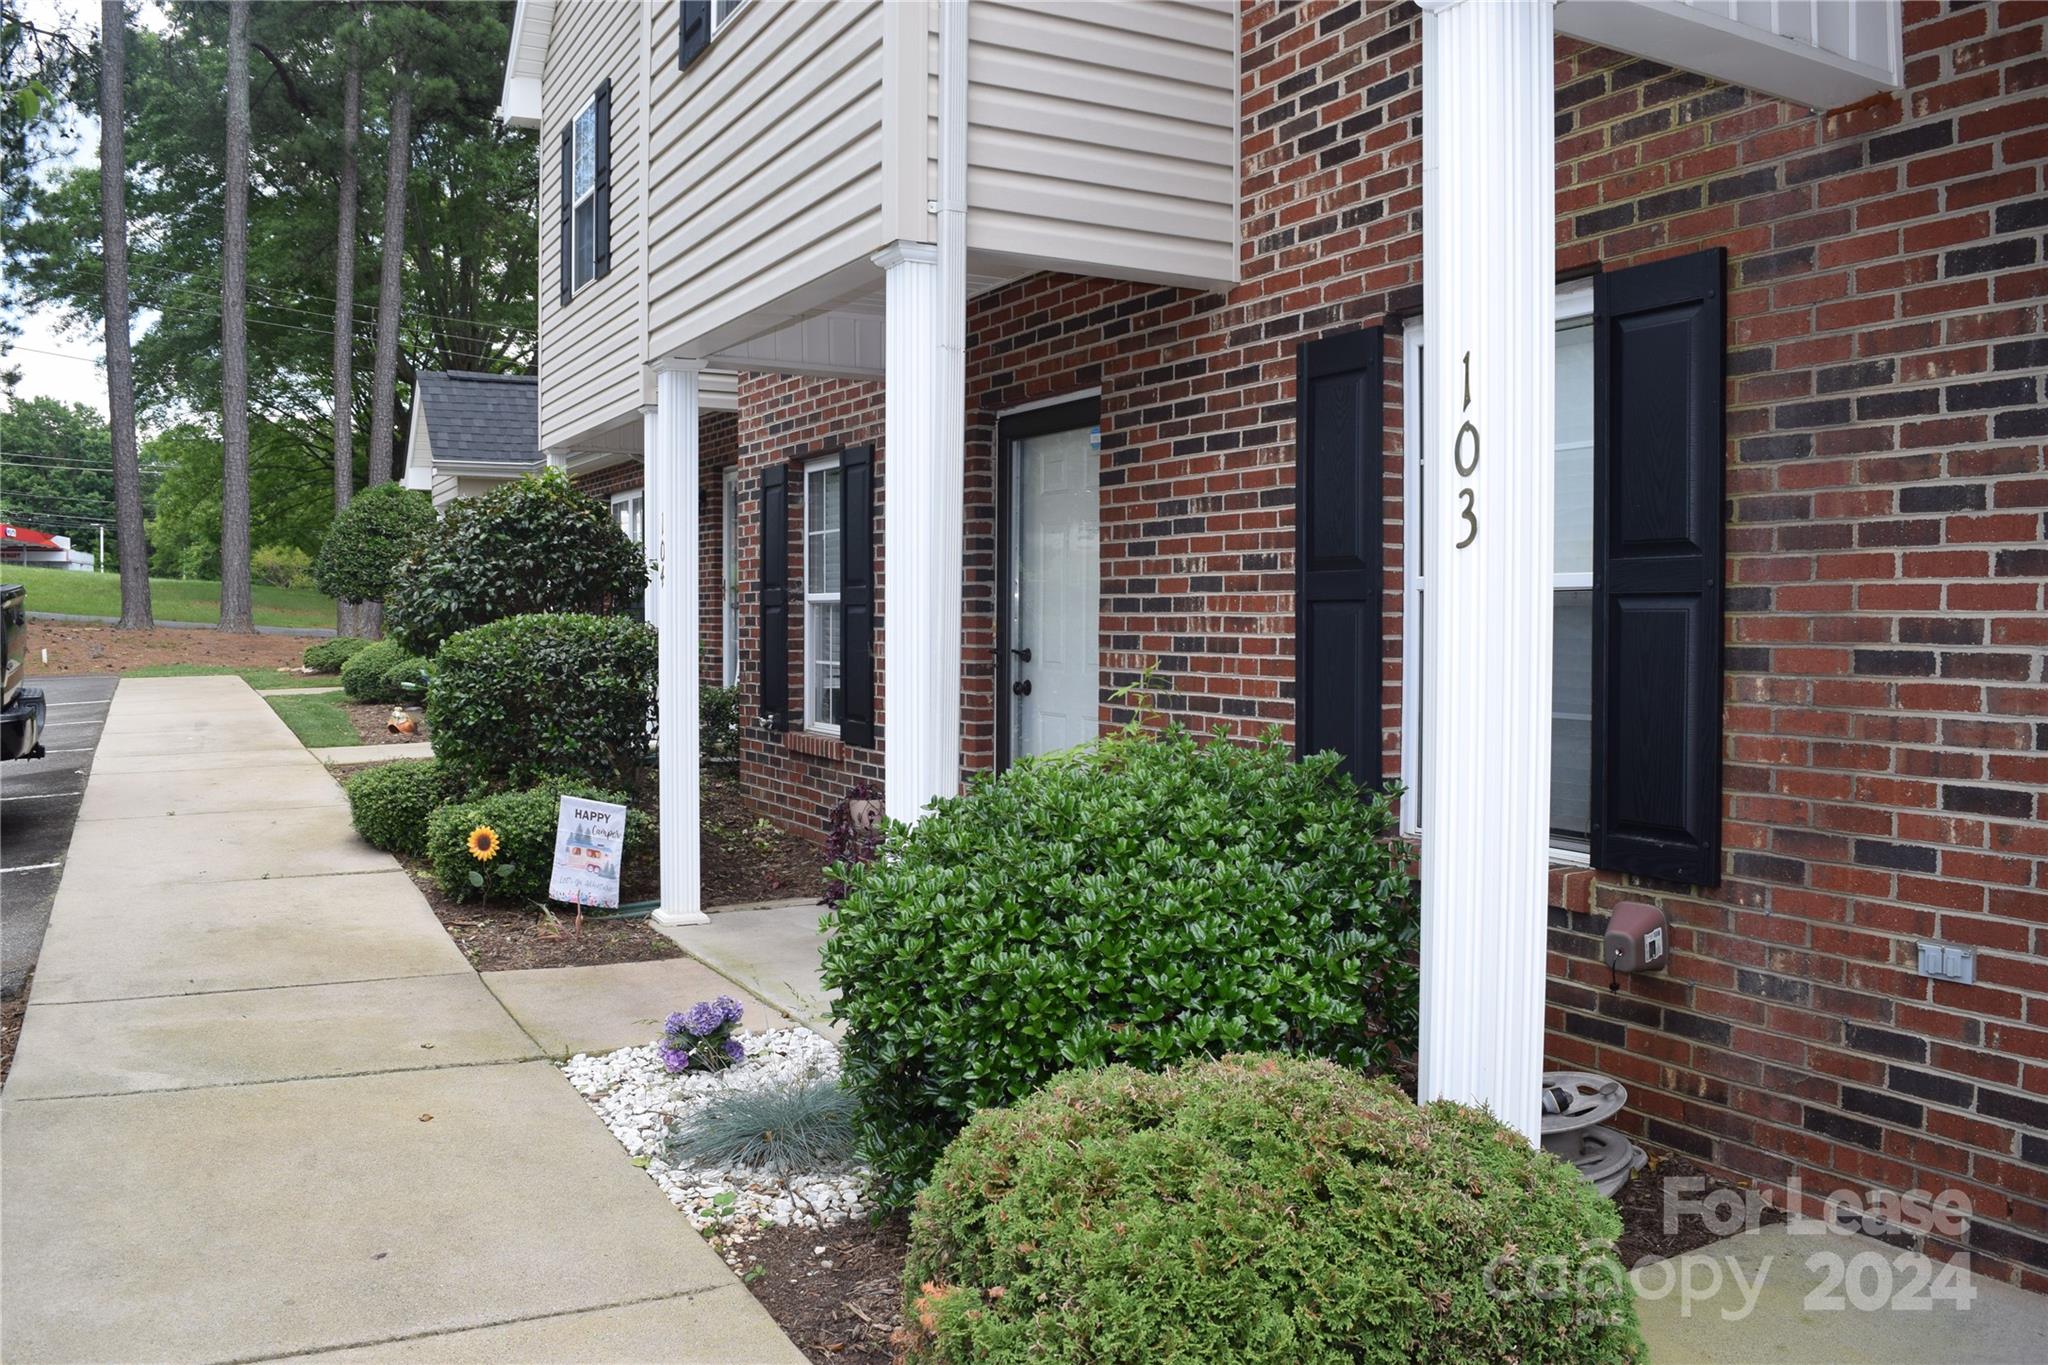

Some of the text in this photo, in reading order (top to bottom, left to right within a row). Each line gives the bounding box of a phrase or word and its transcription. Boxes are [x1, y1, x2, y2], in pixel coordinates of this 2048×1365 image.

[1454, 350, 1481, 550] 103
[575, 808, 612, 824] HAPPY
[591, 824, 622, 840] Camper
